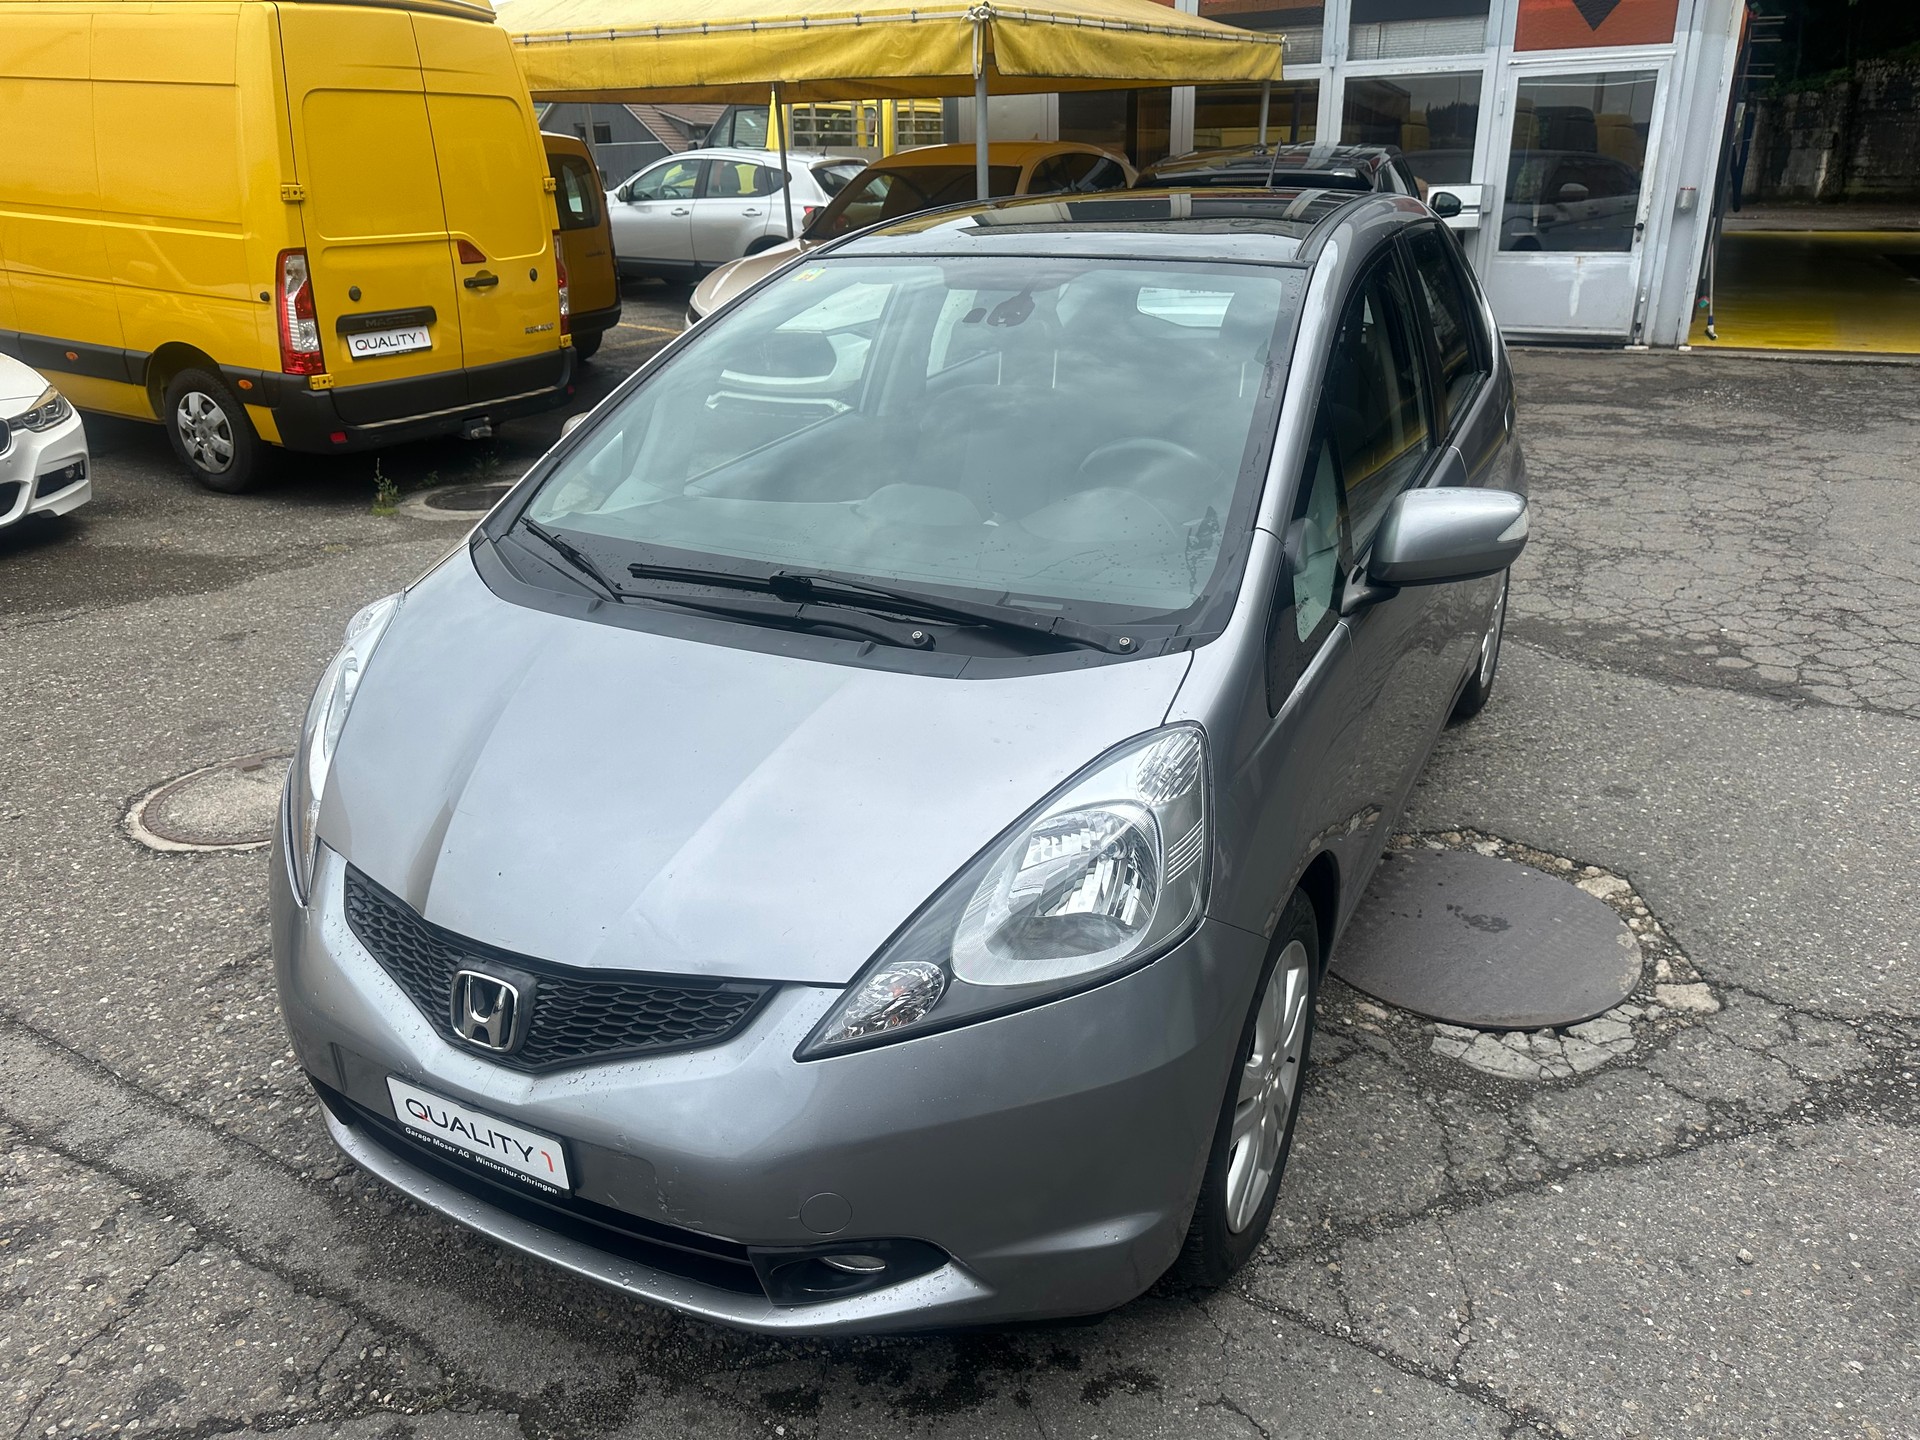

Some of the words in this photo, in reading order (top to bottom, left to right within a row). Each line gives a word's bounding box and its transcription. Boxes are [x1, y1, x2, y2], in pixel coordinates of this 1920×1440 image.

[355, 332, 416, 351] QUALITY
[405, 1098, 534, 1163] QUALITY
[541, 1150, 554, 1173] 1
[405, 1127, 431, 1144] Garage
[433, 1138, 456, 1154] Moser
[458, 1149, 470, 1159] AG
[475, 1155, 558, 1195] Winterthur-Ohringen
